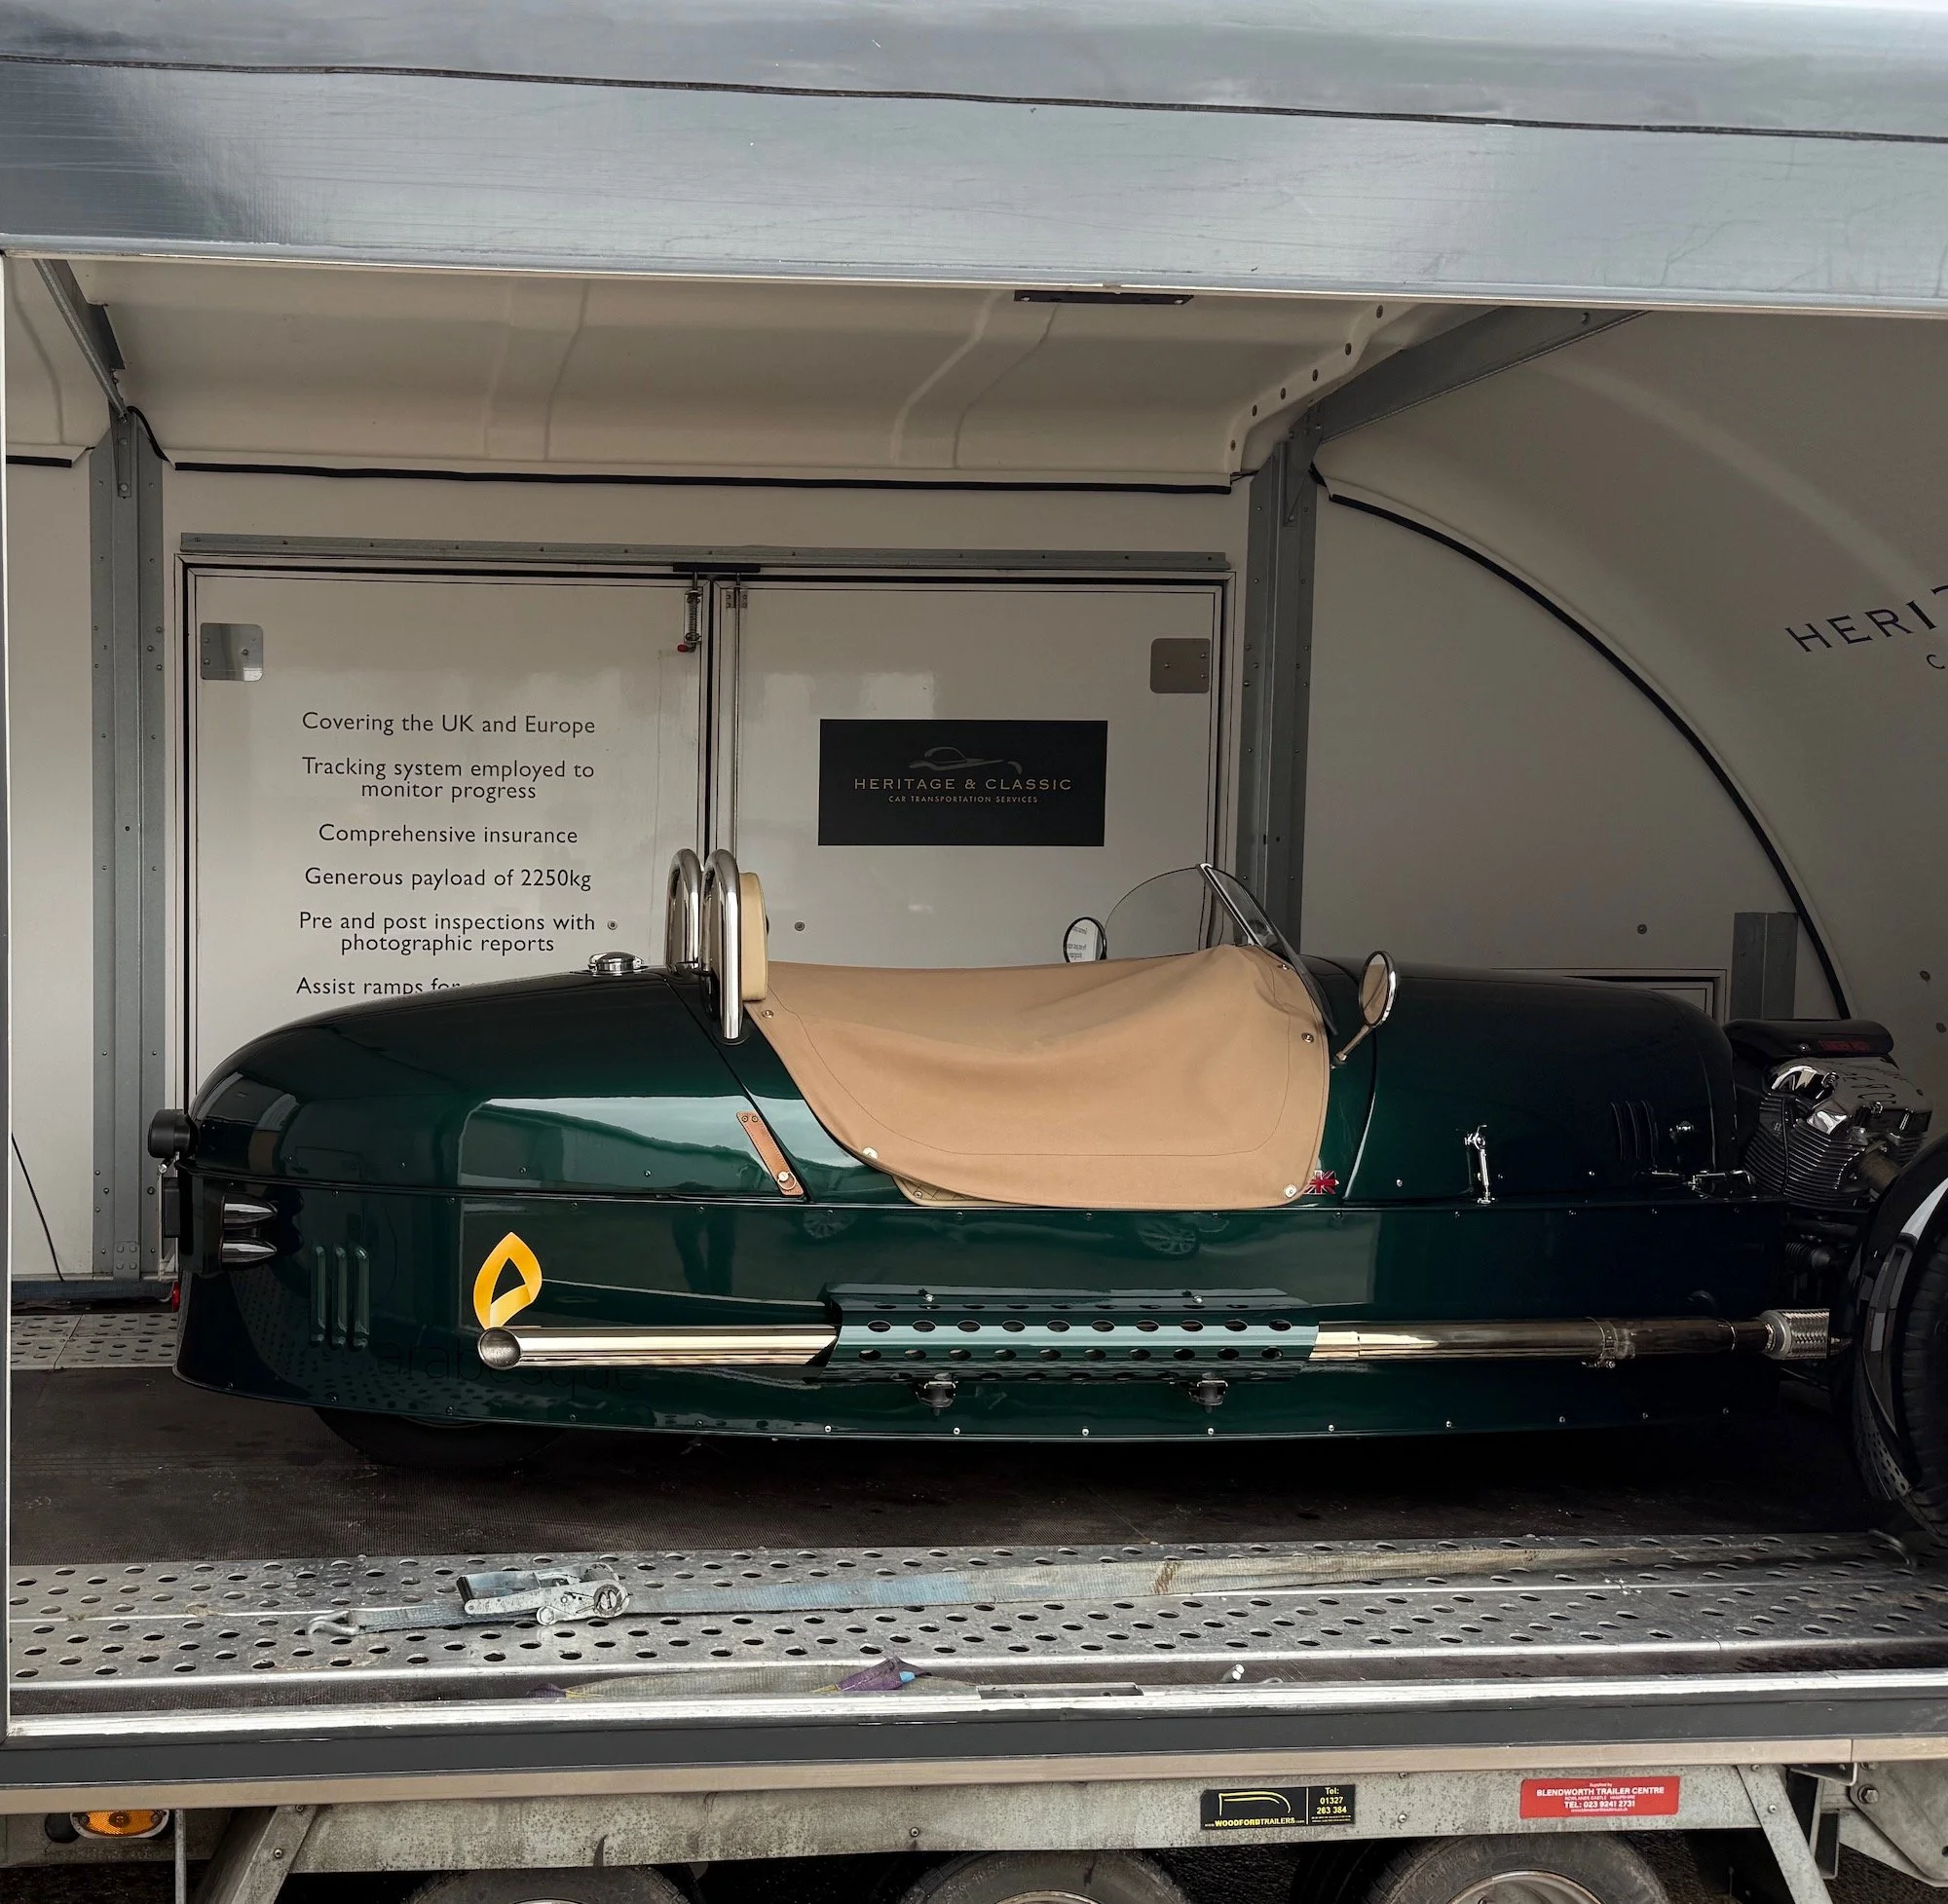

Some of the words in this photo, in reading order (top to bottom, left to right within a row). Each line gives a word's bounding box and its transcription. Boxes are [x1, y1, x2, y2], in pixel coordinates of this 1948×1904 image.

[302, 711, 393, 735] Covering
[401, 714, 433, 731] the
[442, 715, 474, 732] UK
[482, 716, 516, 732] and
[525, 716, 595, 738] Europe
[302, 756, 386, 780] Tracking
[393, 760, 462, 780] system
[470, 761, 565, 781] employed
[574, 764, 594, 777] to
[361, 781, 443, 798] monitor
[451, 783, 537, 803] progress
[854, 778, 955, 790] HERITAGE
[964, 779, 976, 790] &
[986, 779, 1071, 791] CLASSIC
[318, 824, 475, 846] Comprehensive
[484, 827, 578, 843] insurance
[305, 867, 403, 886] Generous
[412, 869, 485, 891] payload
[494, 869, 515, 886] of
[521, 869, 591, 892] 2250kg
[300, 912, 332, 928] Pre
[340, 913, 375, 929] and
[384, 915, 427, 934] post
[434, 914, 544, 934] inspections
[552, 915, 595, 931] with
[341, 934, 472, 955] photographic
[481, 937, 554, 955] reports
[296, 977, 356, 994] Assist
[364, 982, 423, 994] ramps
